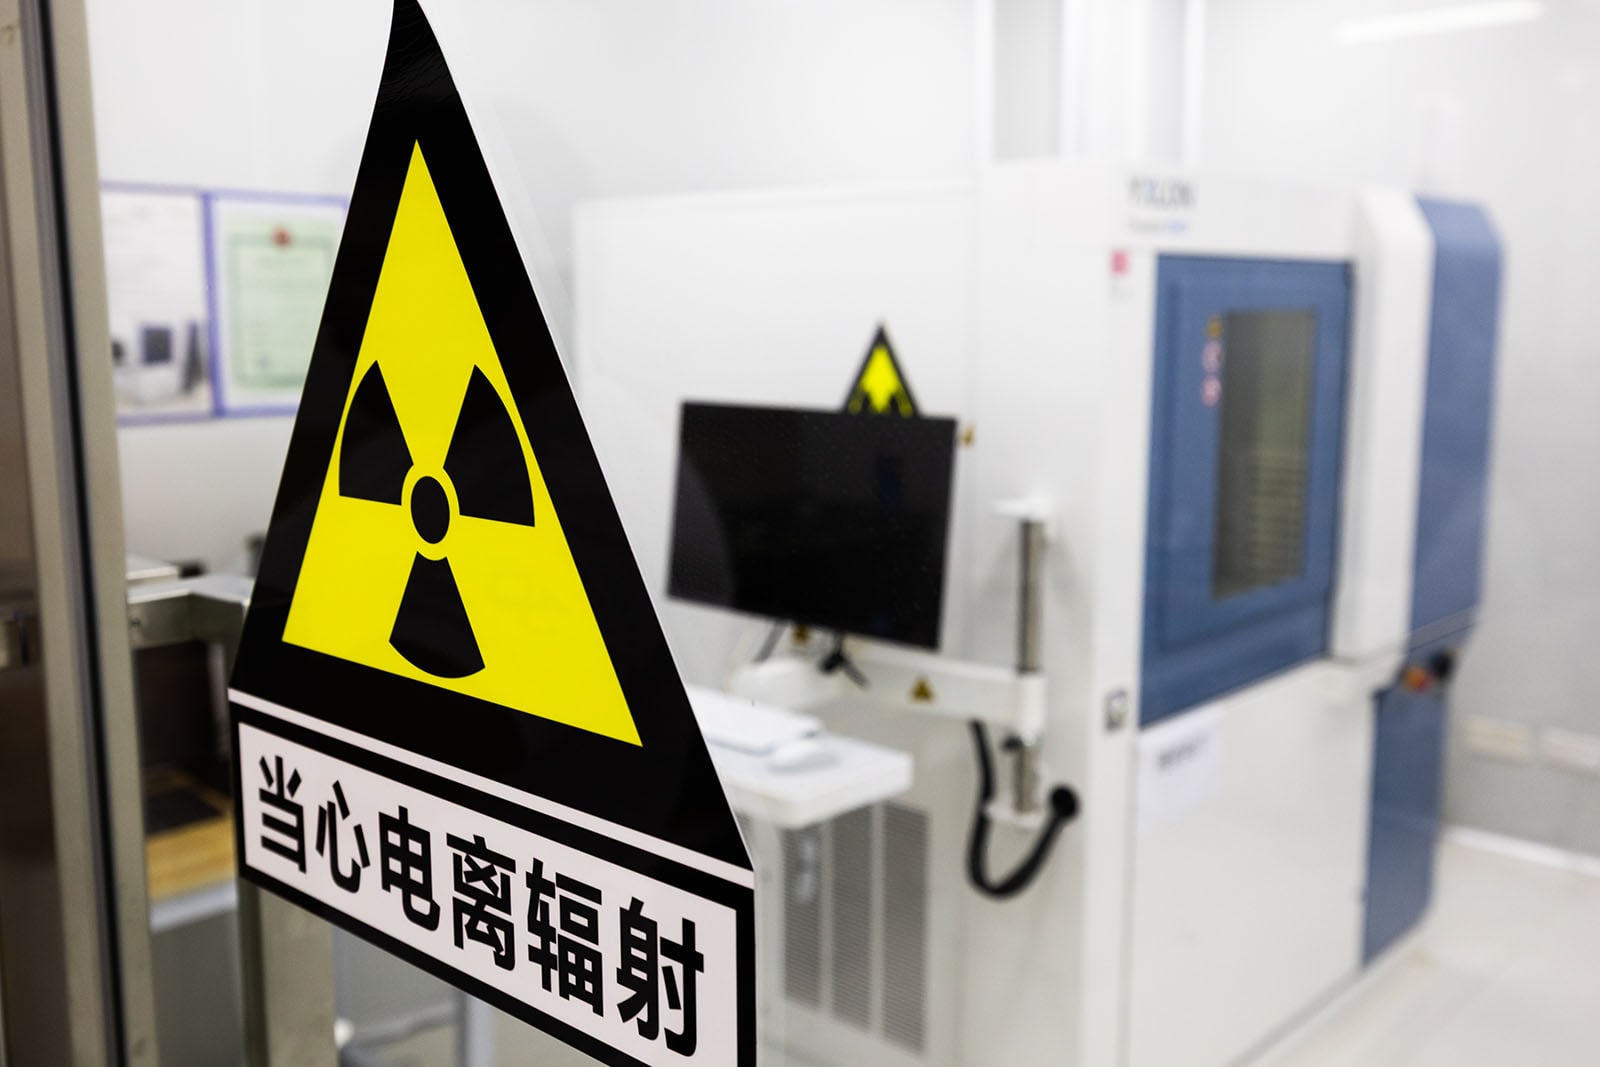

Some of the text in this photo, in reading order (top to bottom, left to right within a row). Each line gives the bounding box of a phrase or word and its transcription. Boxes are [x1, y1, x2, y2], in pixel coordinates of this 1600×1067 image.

[259, 755, 705, 1058] 当心电离辐射
